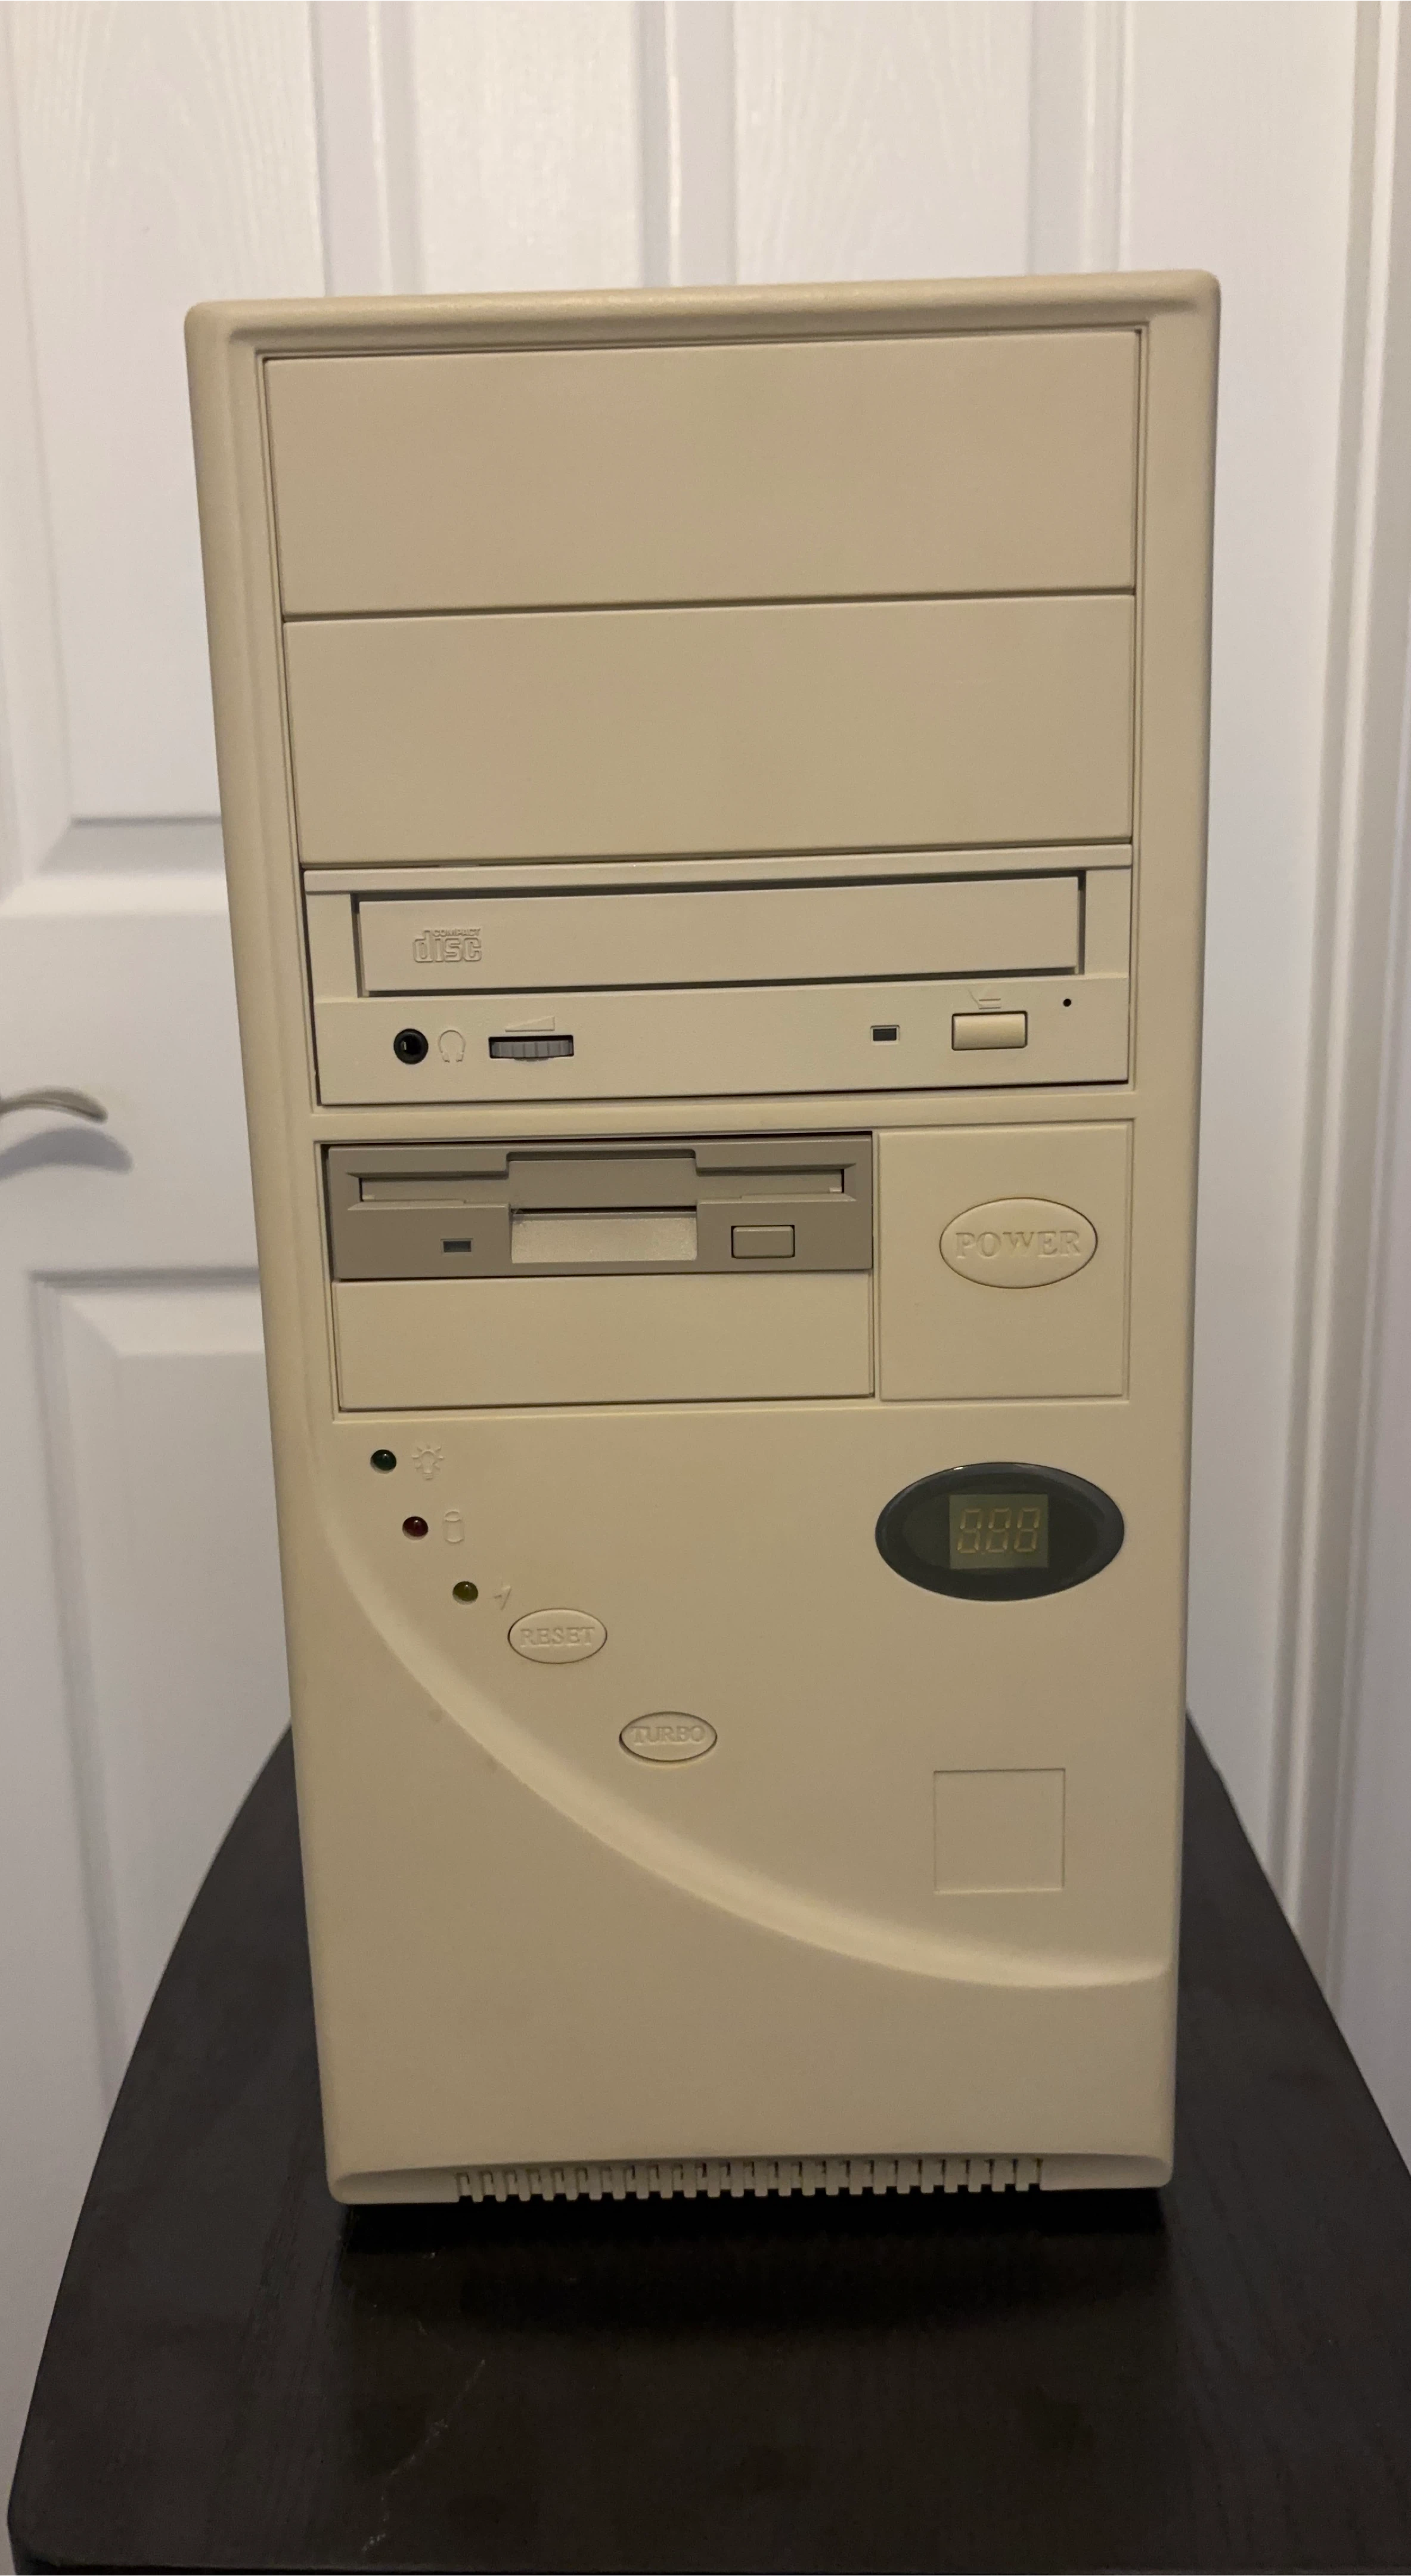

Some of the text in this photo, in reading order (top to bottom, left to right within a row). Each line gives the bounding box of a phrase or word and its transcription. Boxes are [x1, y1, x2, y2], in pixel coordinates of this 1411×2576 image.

[433, 928, 480, 937] COMPACT
[956, 1230, 1081, 1259] POWER
[520, 1627, 595, 1648] RESET
[629, 1725, 706, 1745] TURBO
